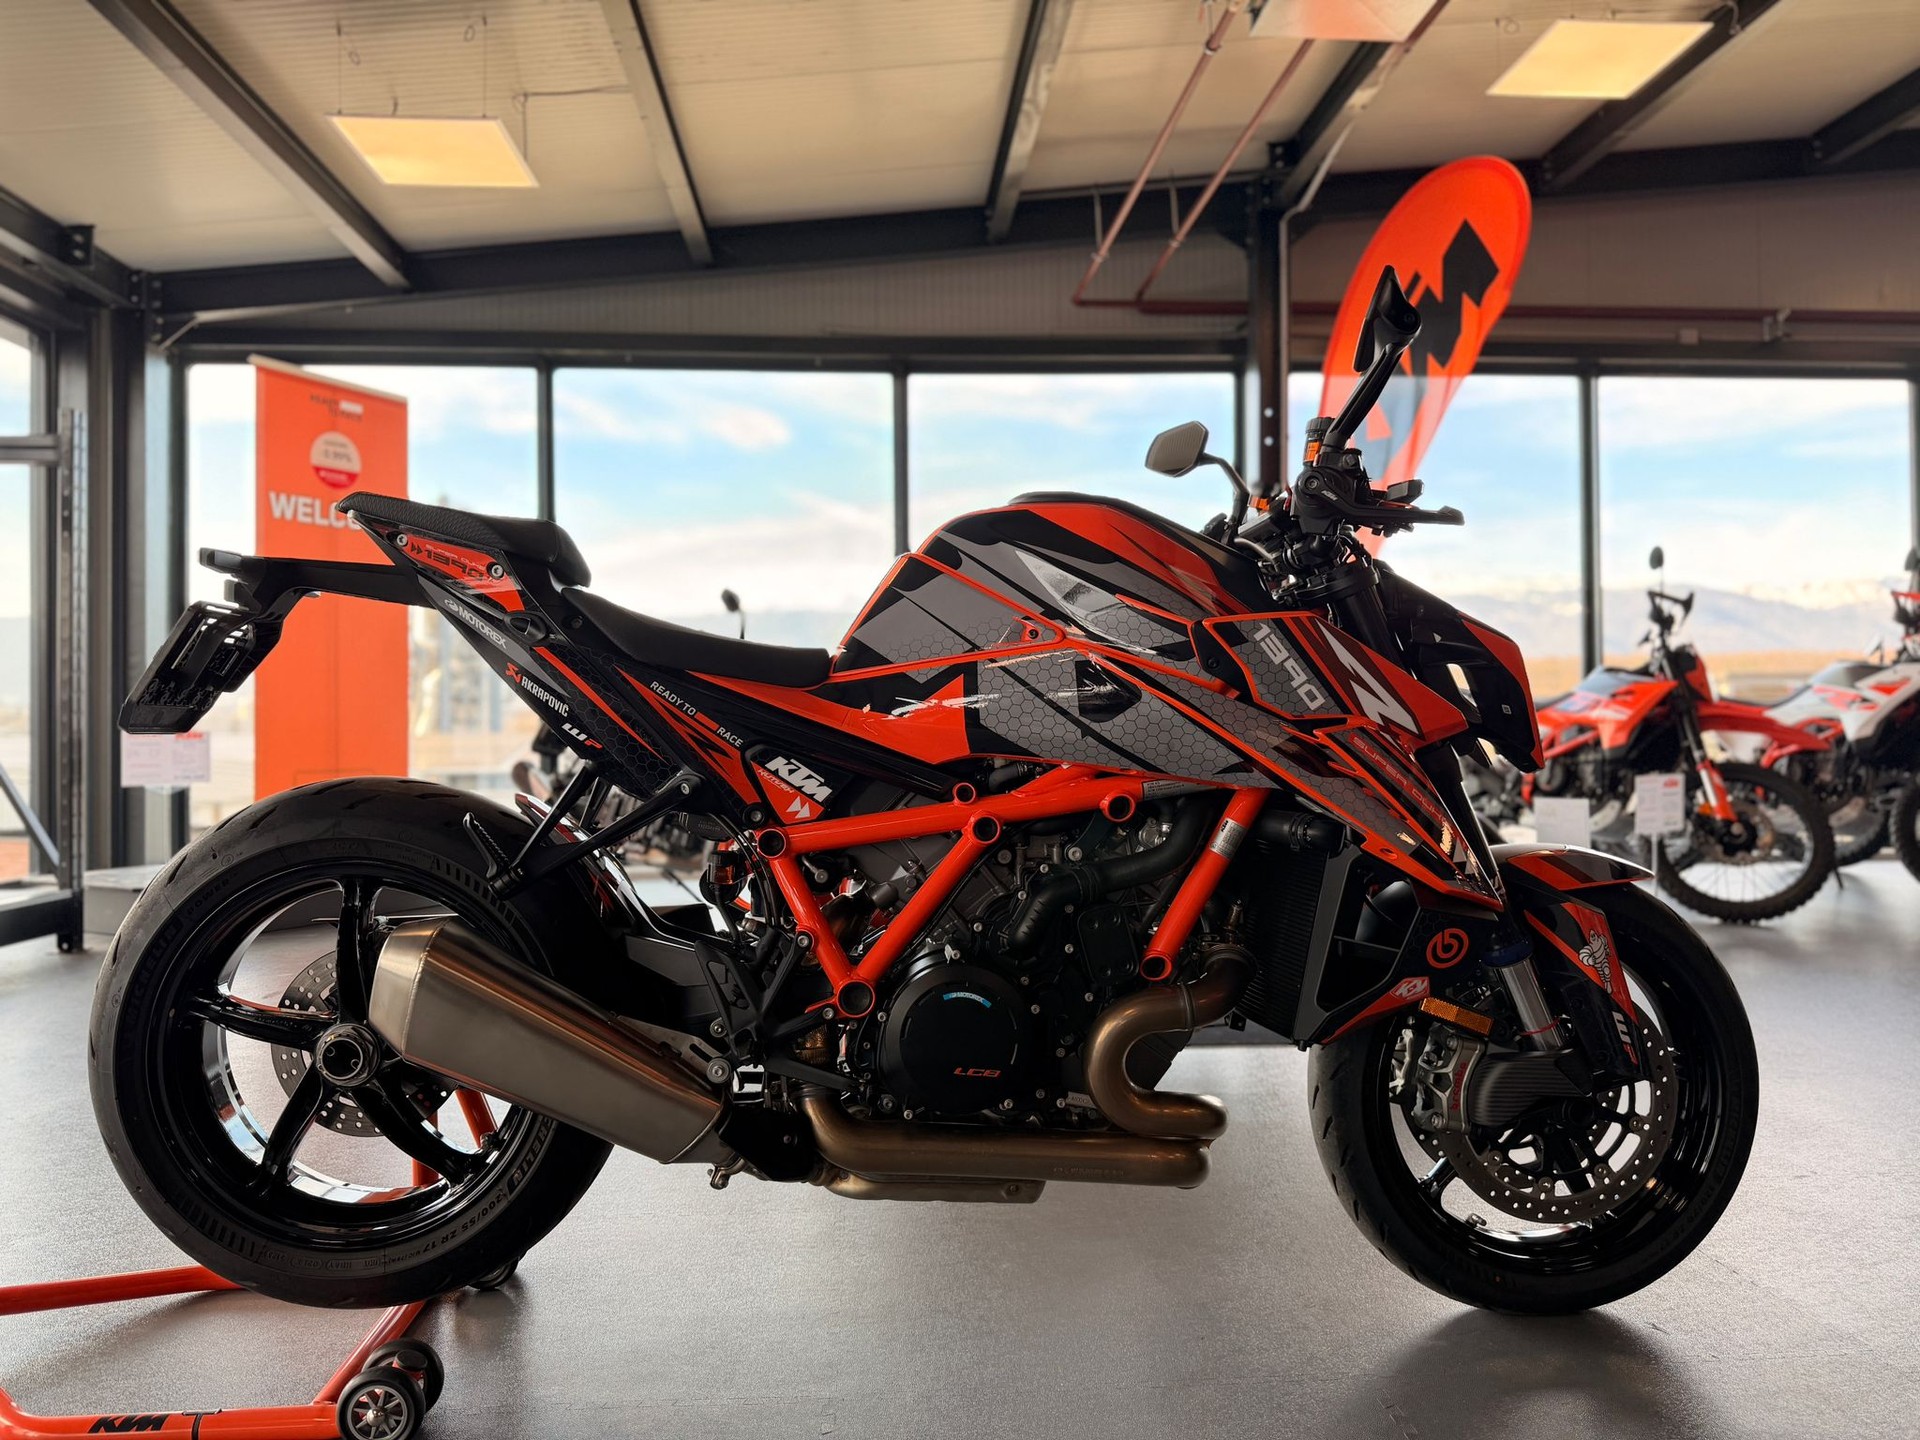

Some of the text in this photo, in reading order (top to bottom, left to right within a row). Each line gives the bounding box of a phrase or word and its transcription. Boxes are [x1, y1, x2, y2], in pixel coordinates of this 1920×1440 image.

[268, 490, 361, 530] WELC
[458, 607, 507, 649] MOTOREX
[1253, 622, 1326, 711] 1390
[650, 681, 697, 716] READY TO
[561, 722, 603, 749] WP
[716, 726, 744, 748] RACE
[764, 755, 833, 802] KTM
[1353, 736, 1408, 786] SUPER
[953, 1066, 1002, 1078] LC8
[88, 1413, 169, 1434] KTM
